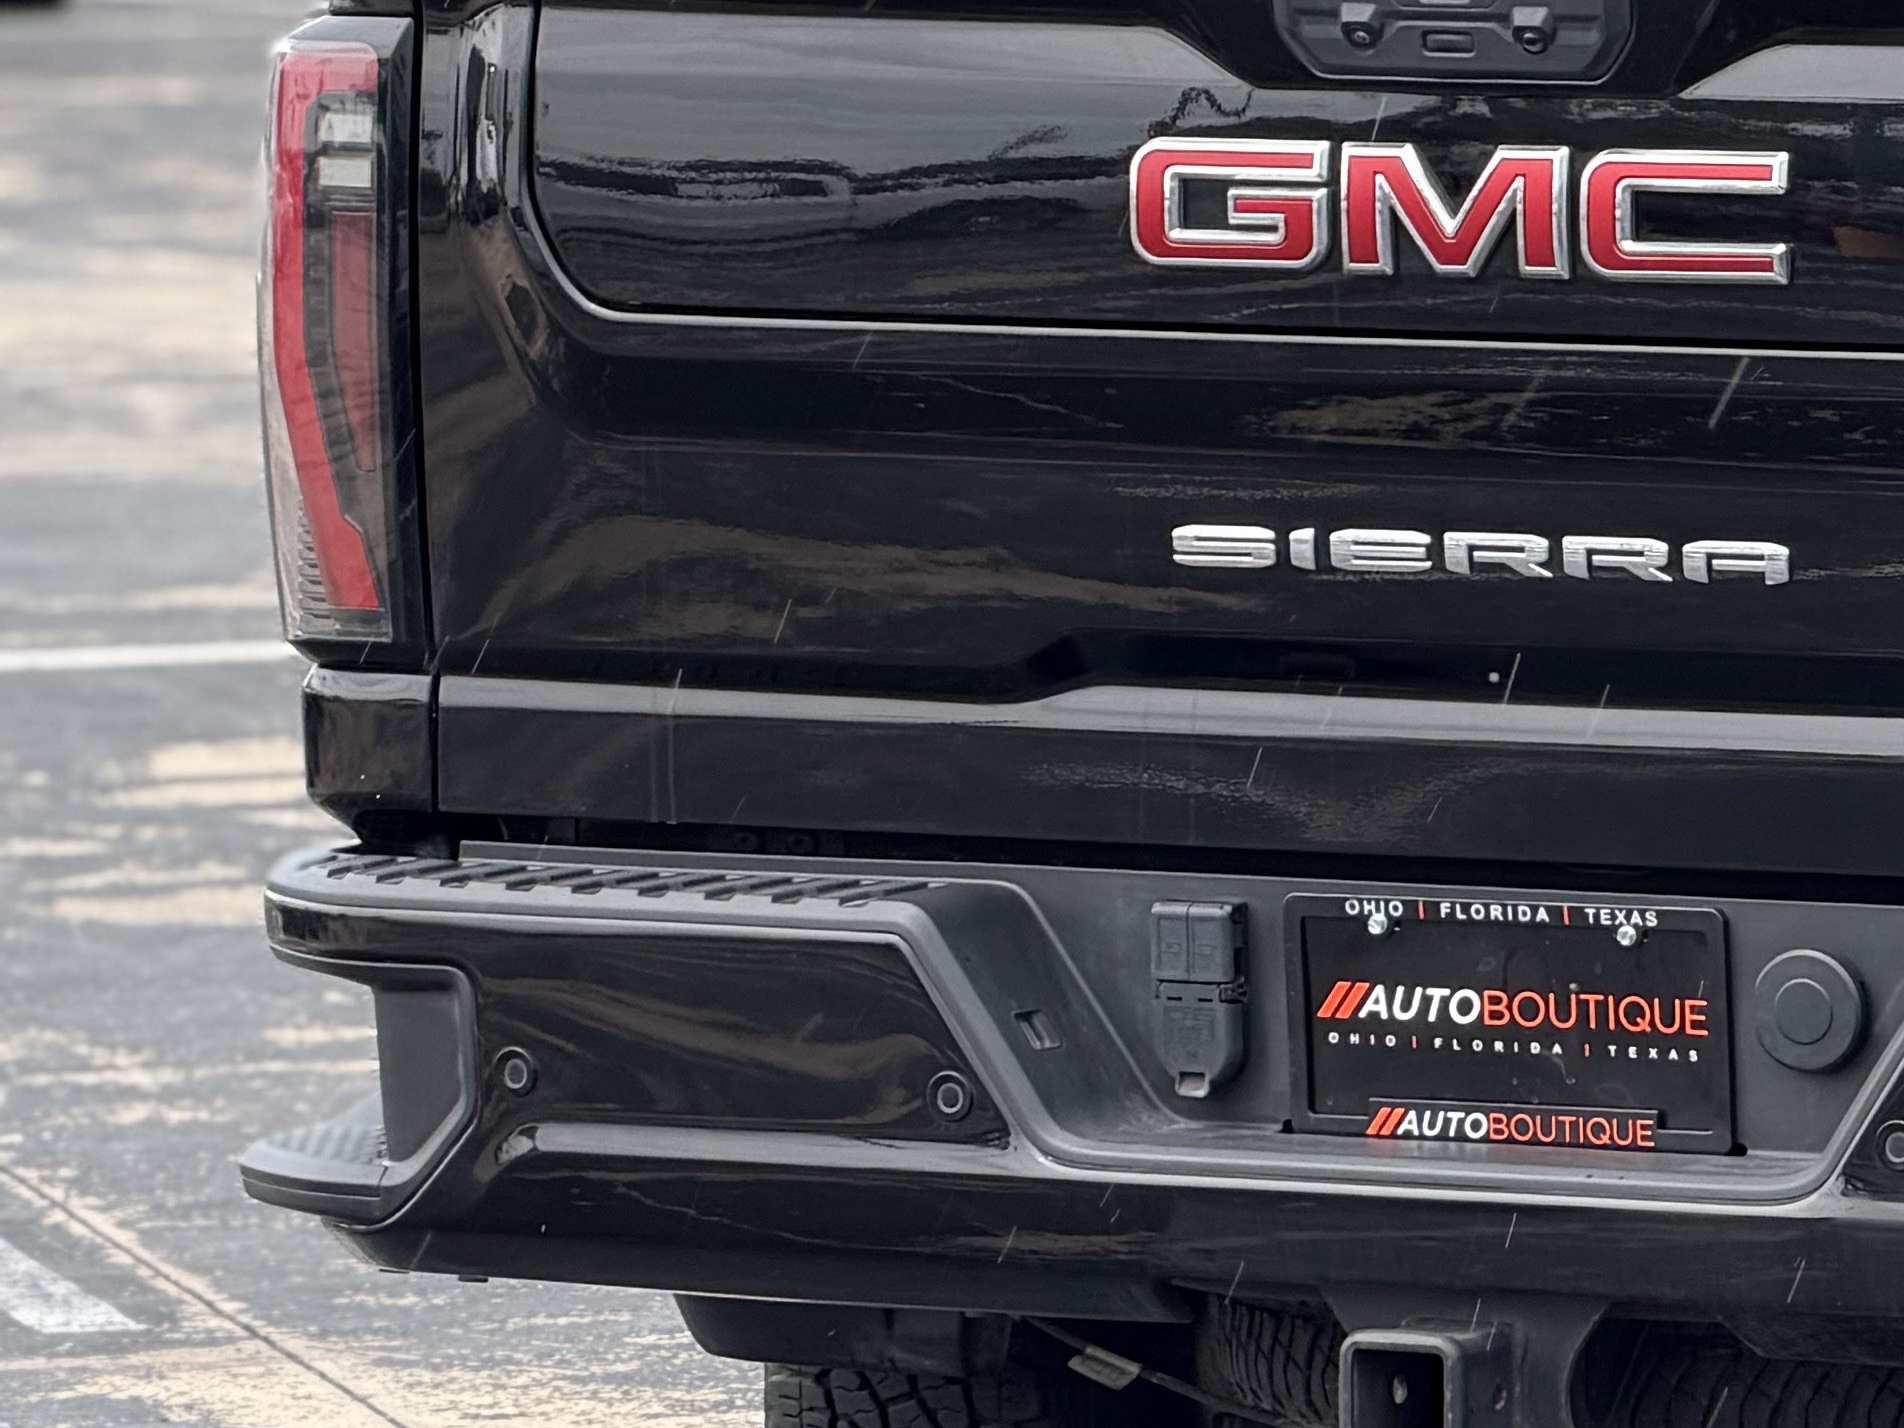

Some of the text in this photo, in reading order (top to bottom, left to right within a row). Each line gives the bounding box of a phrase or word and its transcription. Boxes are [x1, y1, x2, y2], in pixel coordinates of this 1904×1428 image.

[1129, 137, 1791, 286] GMC
[1171, 523, 1791, 586] SIERRA
[1345, 899, 1658, 927] OHIO FLORIDA TEXAS
[1358, 984, 1709, 1036] AUTOBOUTIQUE
[1328, 1032, 1699, 1062] OHIO FLORIDA TEXAS
[1398, 1110, 1655, 1147] AUTOBOUTIQUE
